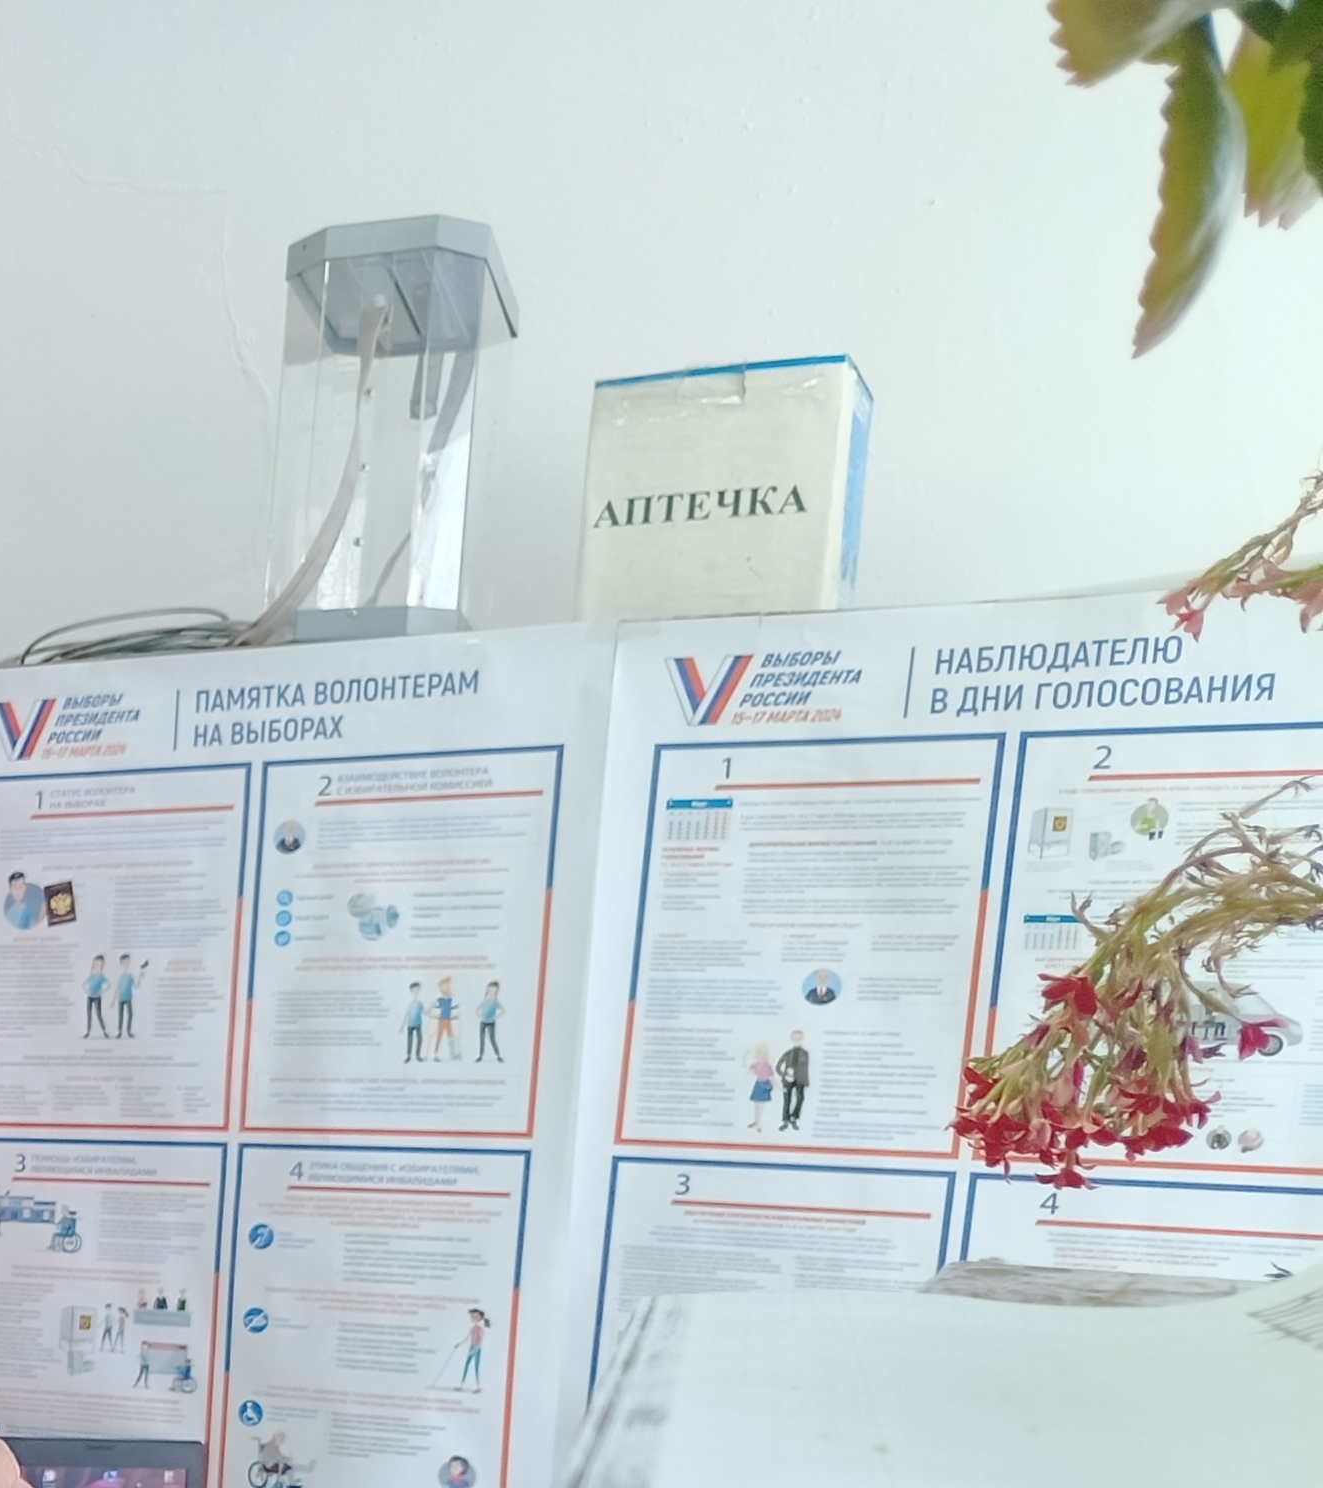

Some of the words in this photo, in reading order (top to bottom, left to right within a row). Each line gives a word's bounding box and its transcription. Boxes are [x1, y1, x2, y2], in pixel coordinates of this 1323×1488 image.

[593, 484, 808, 529] АПТЕЧКА
[760, 650, 842, 668] ВЫБОРЫ
[934, 635, 1183, 675] НАБЛЮДАТЕЛЮ
[749, 669, 862, 689] ПРЕЗИДЕНТА
[62, 693, 124, 710] ВЫБОРЫ
[195, 682, 306, 713] ПАМЯТКА
[313, 670, 480, 706] ВОЛОНТЕРАМ
[738, 691, 812, 708] РОССИИ
[930, 688, 948, 714] В
[955, 684, 1023, 717] ДНИ
[1033, 672, 1276, 710] ГОЛОСОВАНИЯ
[54, 709, 141, 727] ПРЕЗИДЕНТА
[767, 709, 809, 723] МАРТА
[811, 708, 843, 722] 2024
[46, 729, 102, 744] РОССИИ
[193, 723, 223, 747] НА
[230, 715, 344, 745] ВЫБОРАХ
[1093, 745, 1113, 769] 2
[722, 757, 731, 779] 1
[317, 776, 332, 797] 2
[35, 790, 43, 809] 1
[14, 1153, 26, 1173] 3
[289, 1161, 304, 1181] 4
[674, 1173, 690, 1195] 3
[1040, 1192, 1059, 1214] 4
